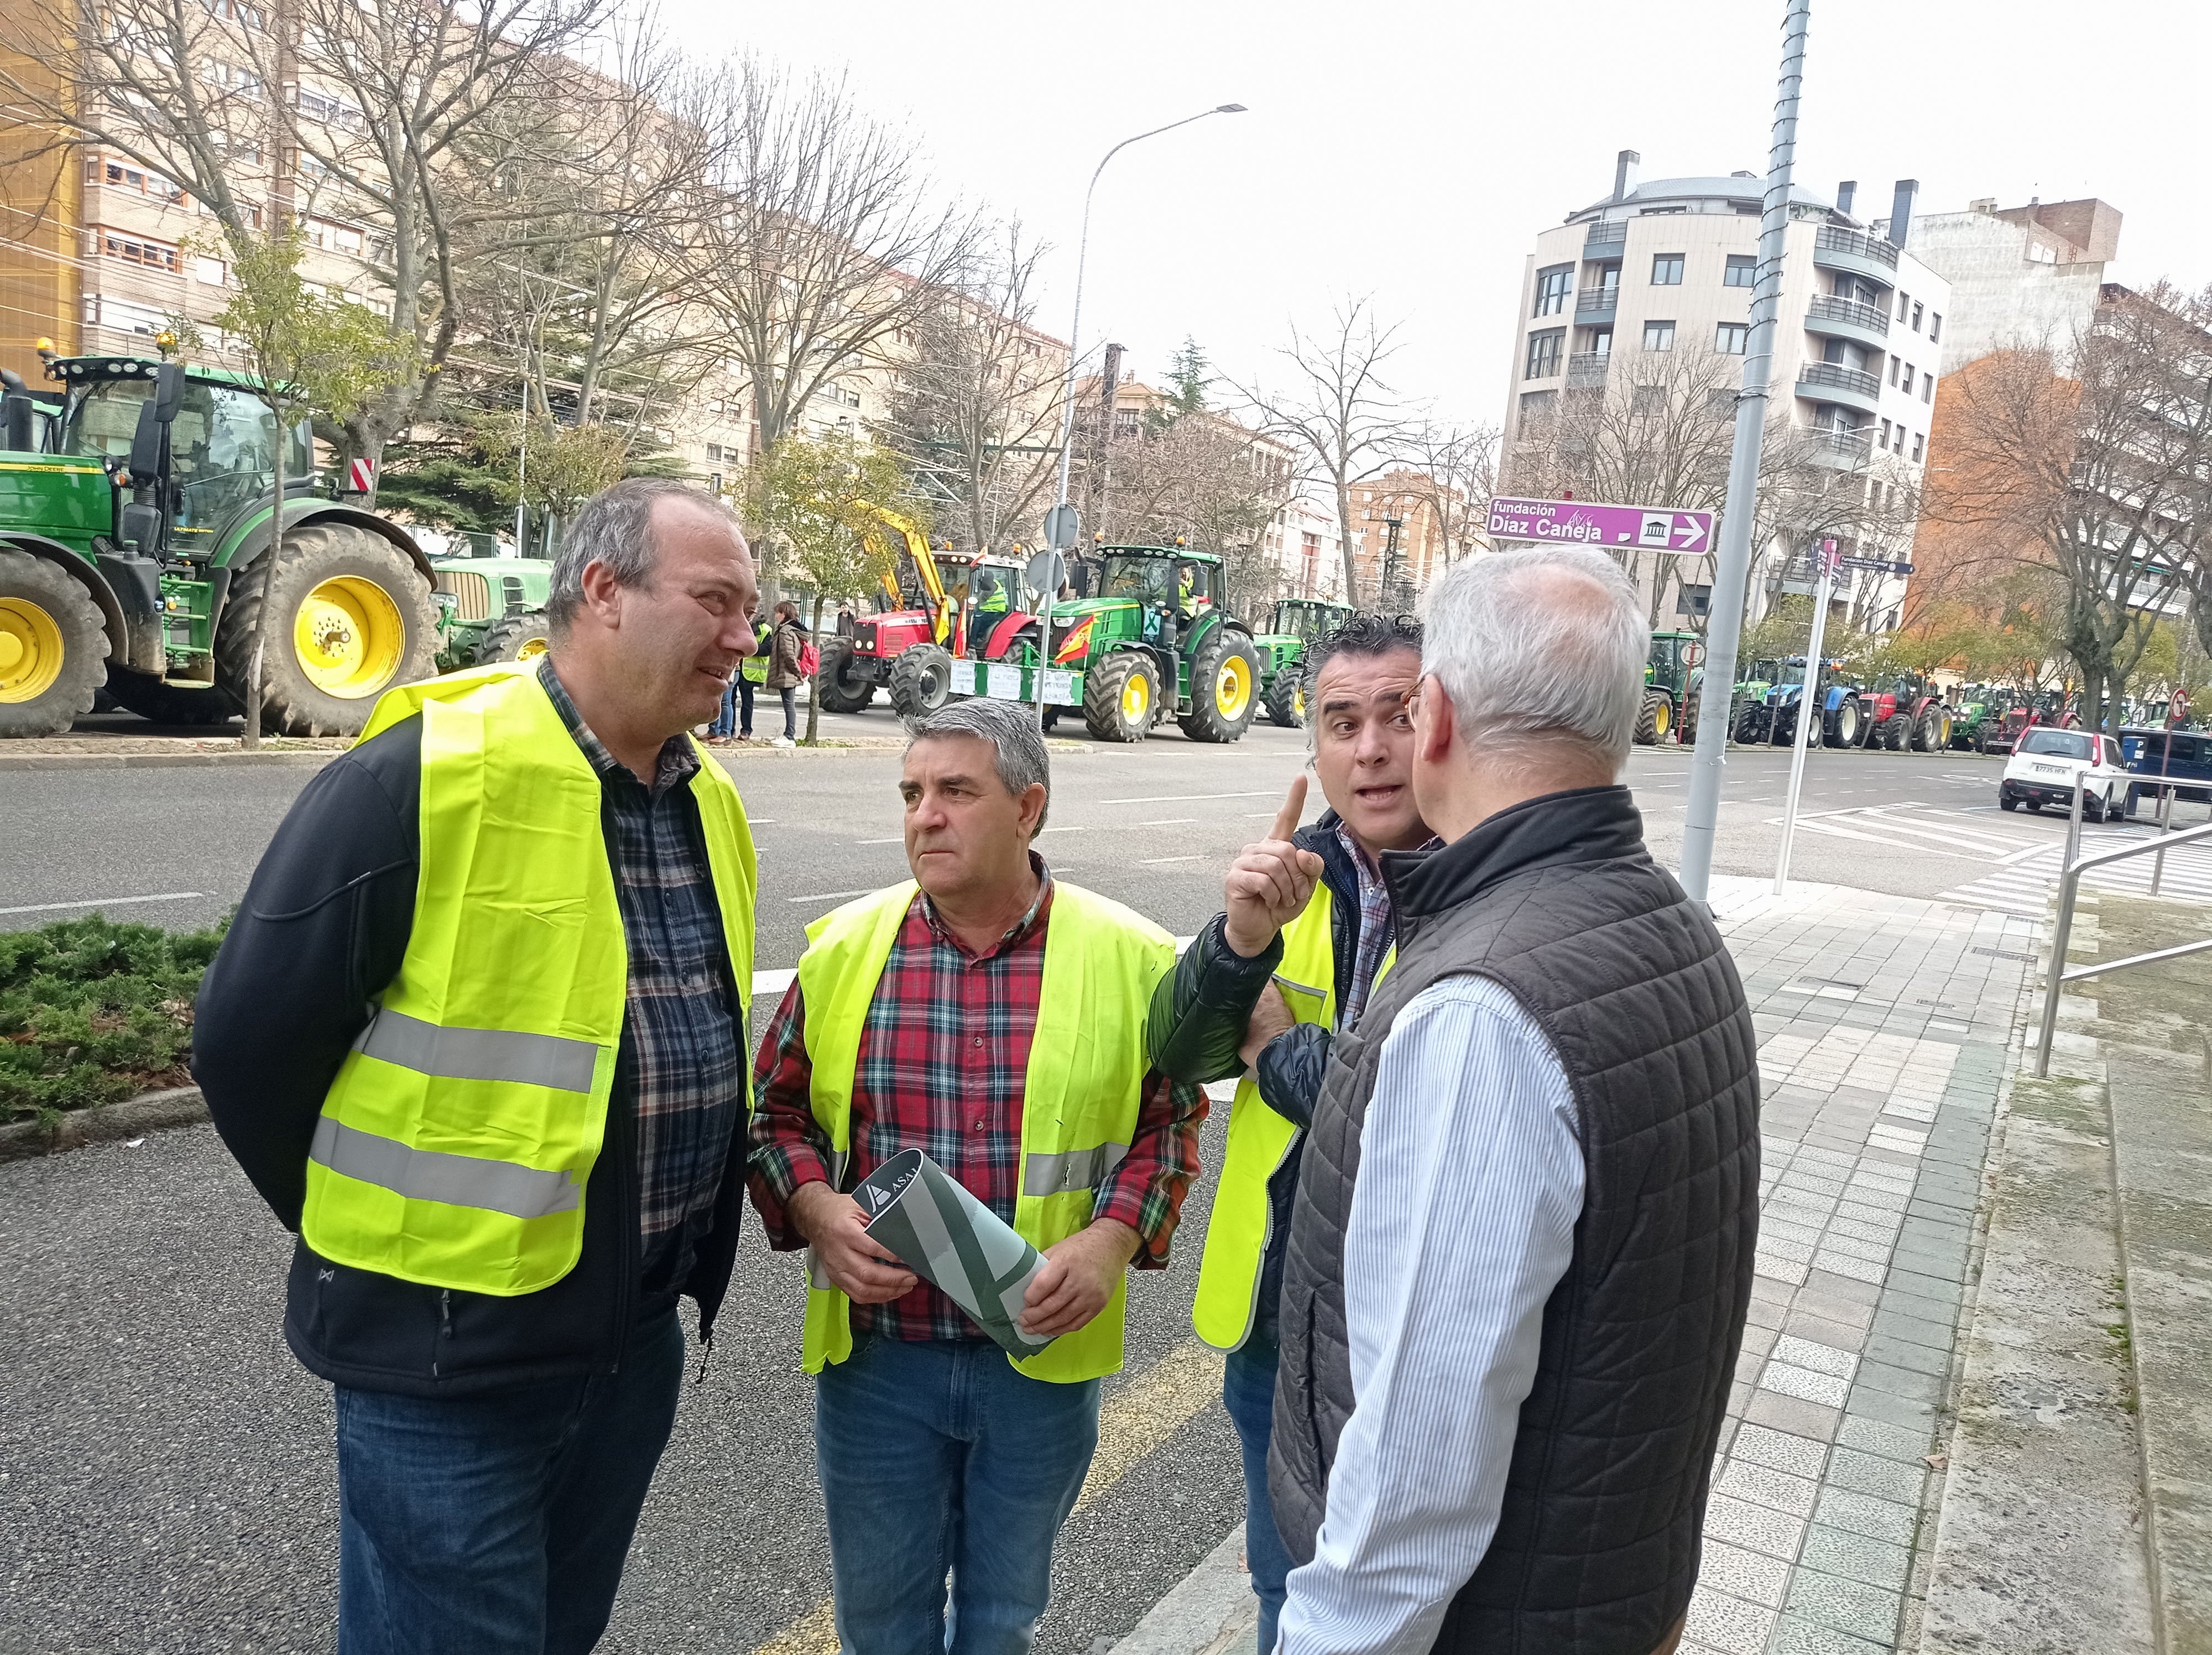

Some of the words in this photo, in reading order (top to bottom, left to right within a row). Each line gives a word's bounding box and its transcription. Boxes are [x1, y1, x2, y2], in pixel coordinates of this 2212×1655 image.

[1494, 501, 1556, 517] fundación
[1489, 515, 1529, 534] Díaz
[1536, 518, 1601, 543] Caneja
